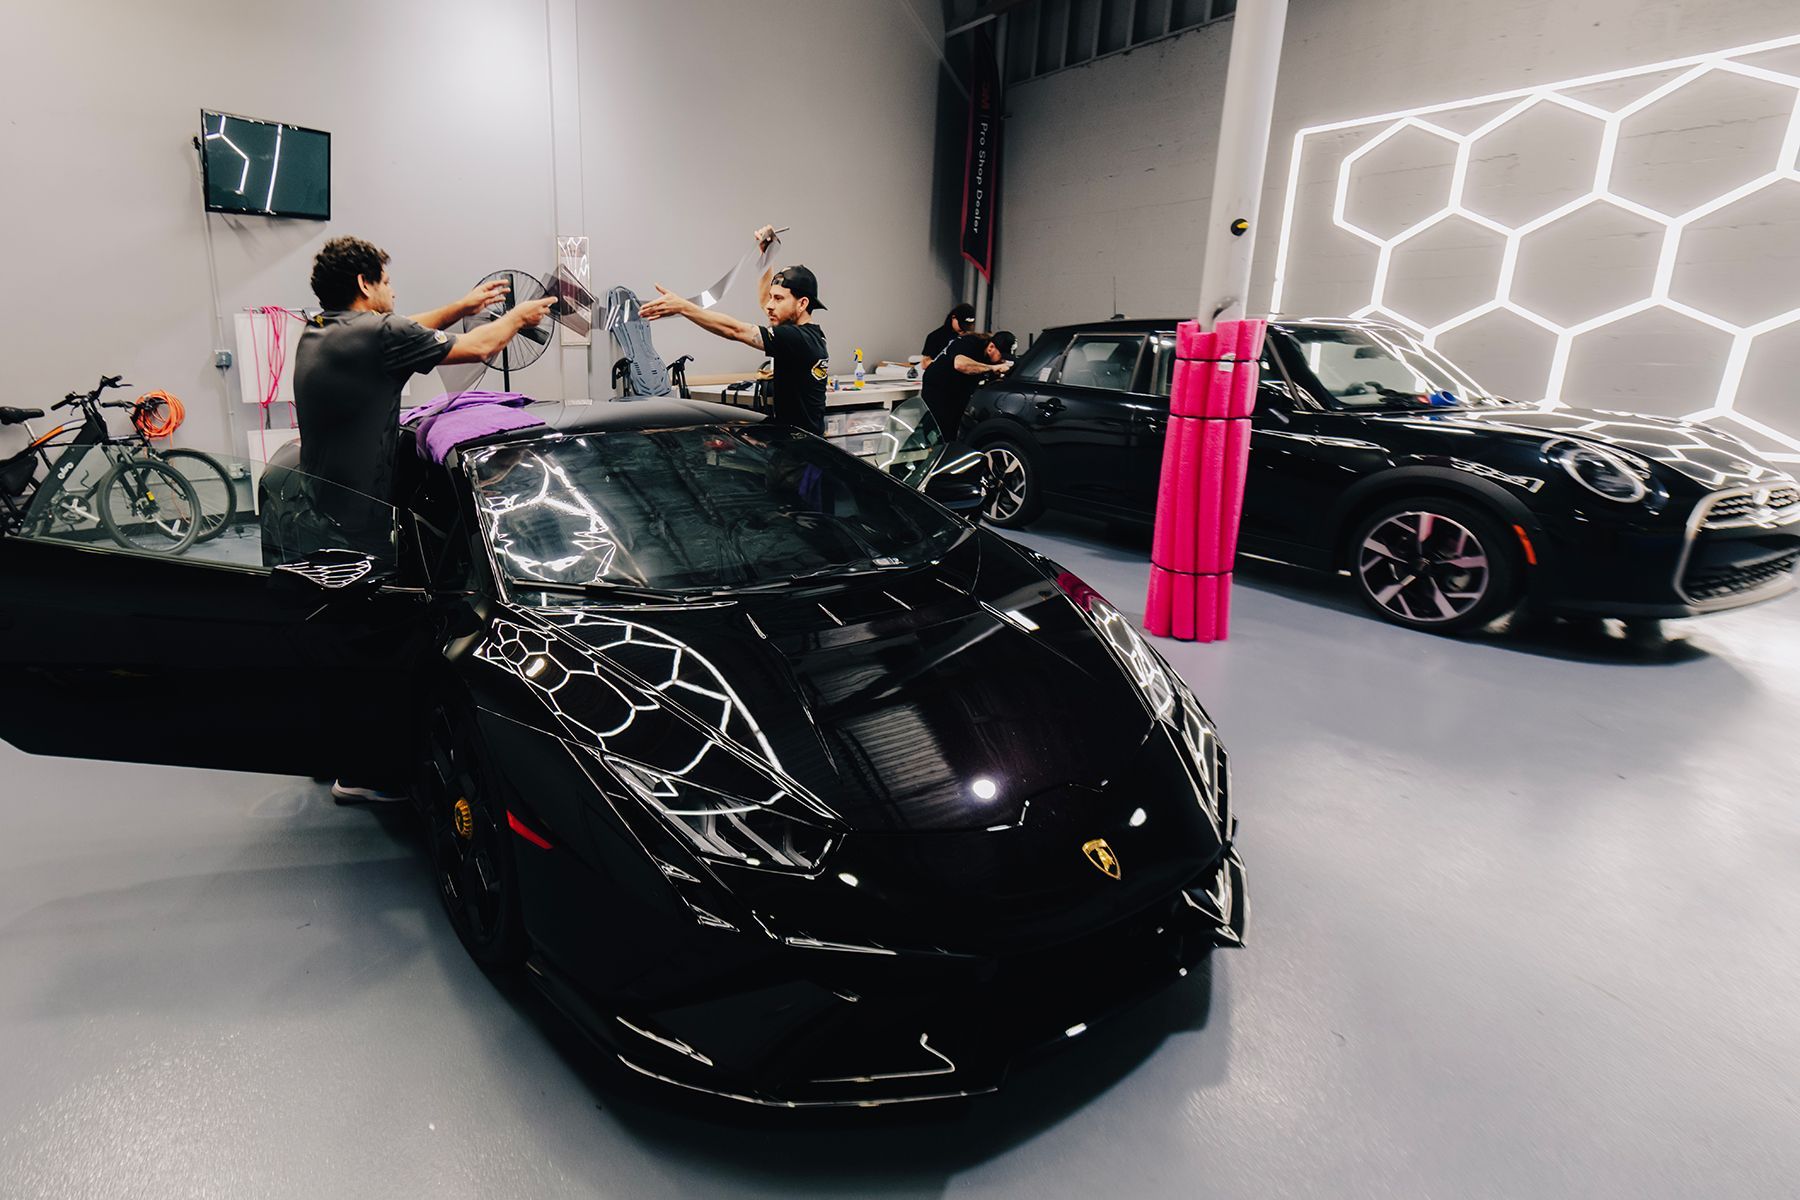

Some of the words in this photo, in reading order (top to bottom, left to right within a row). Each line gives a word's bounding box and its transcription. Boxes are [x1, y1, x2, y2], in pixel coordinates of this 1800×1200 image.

[978, 122, 989, 146] Pro
[976, 150, 987, 185] Shop
[973, 189, 984, 234] Dealer
